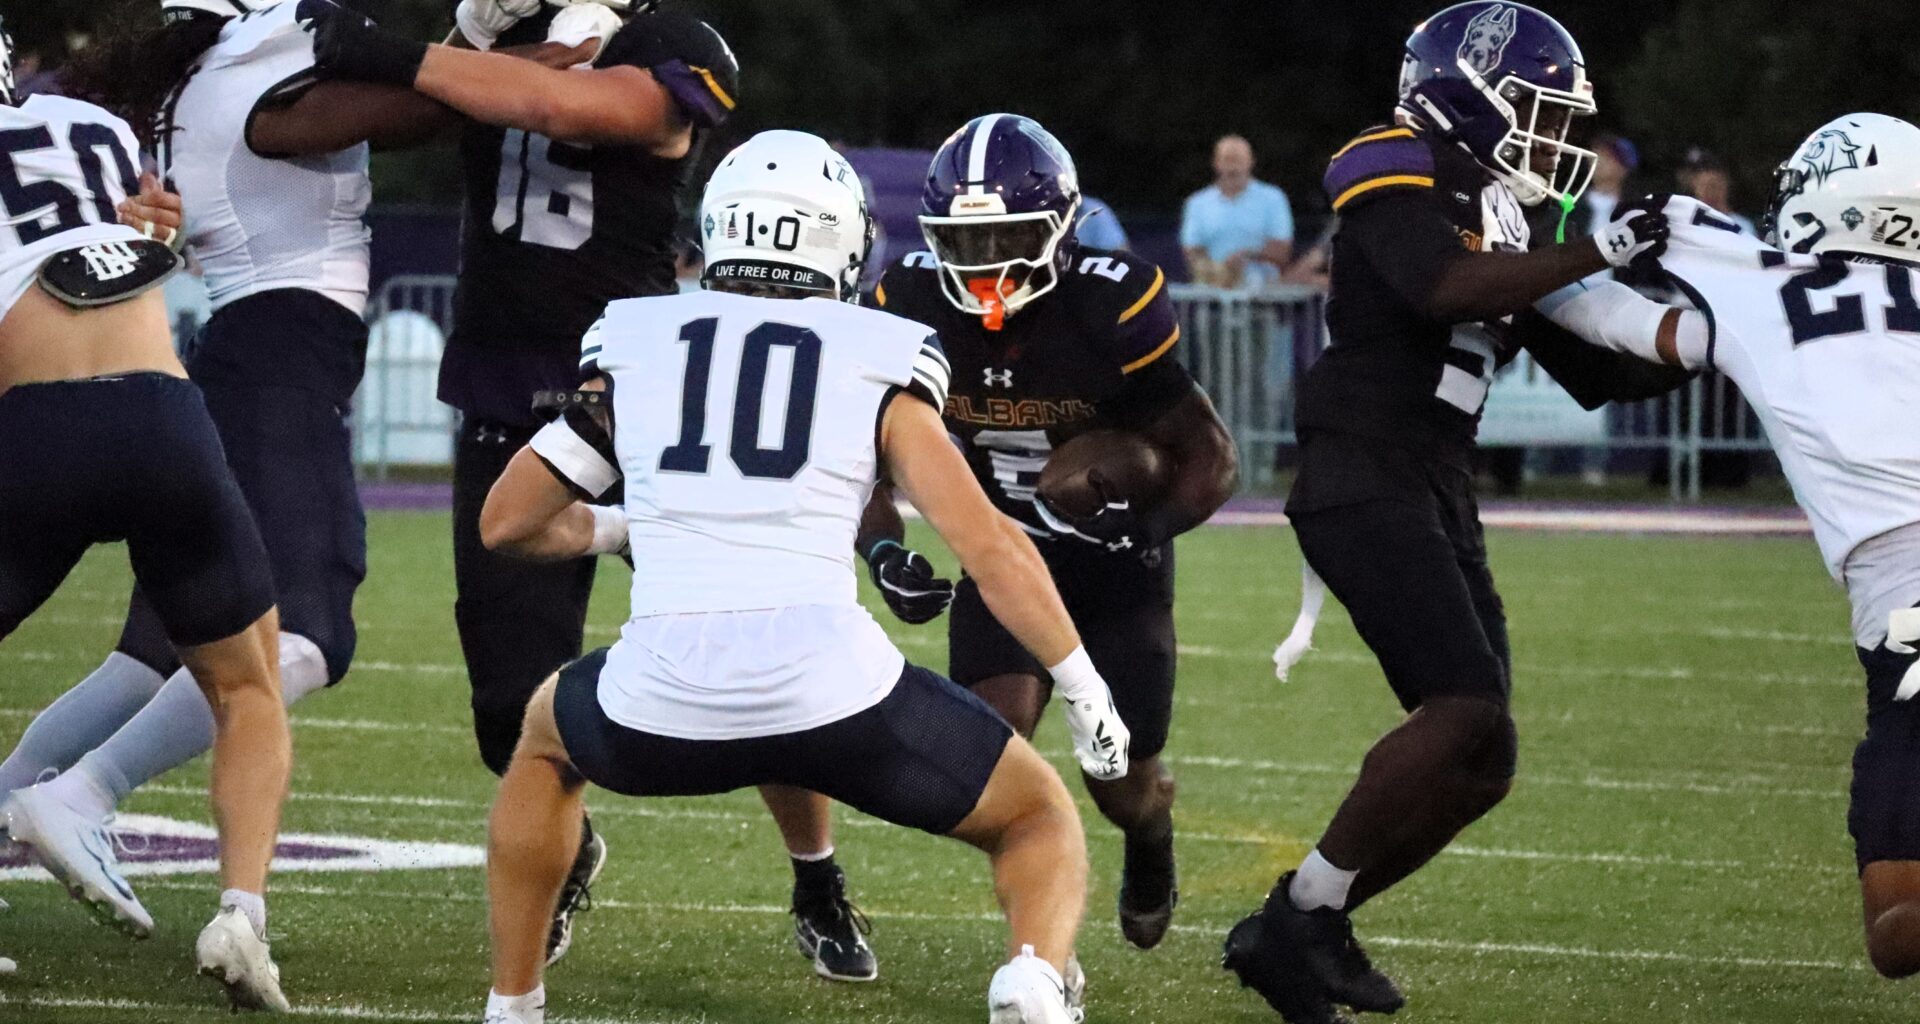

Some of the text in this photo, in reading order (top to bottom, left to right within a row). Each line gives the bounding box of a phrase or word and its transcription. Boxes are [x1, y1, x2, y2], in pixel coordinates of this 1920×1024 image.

[0, 121, 141, 246] 50
[819, 213, 837, 225] CAA
[715, 265, 815, 284] LIVE FREE OR DIE
[1078, 256, 1130, 283] 2
[1759, 249, 1920, 351] 21
[655, 314, 826, 483] 10
